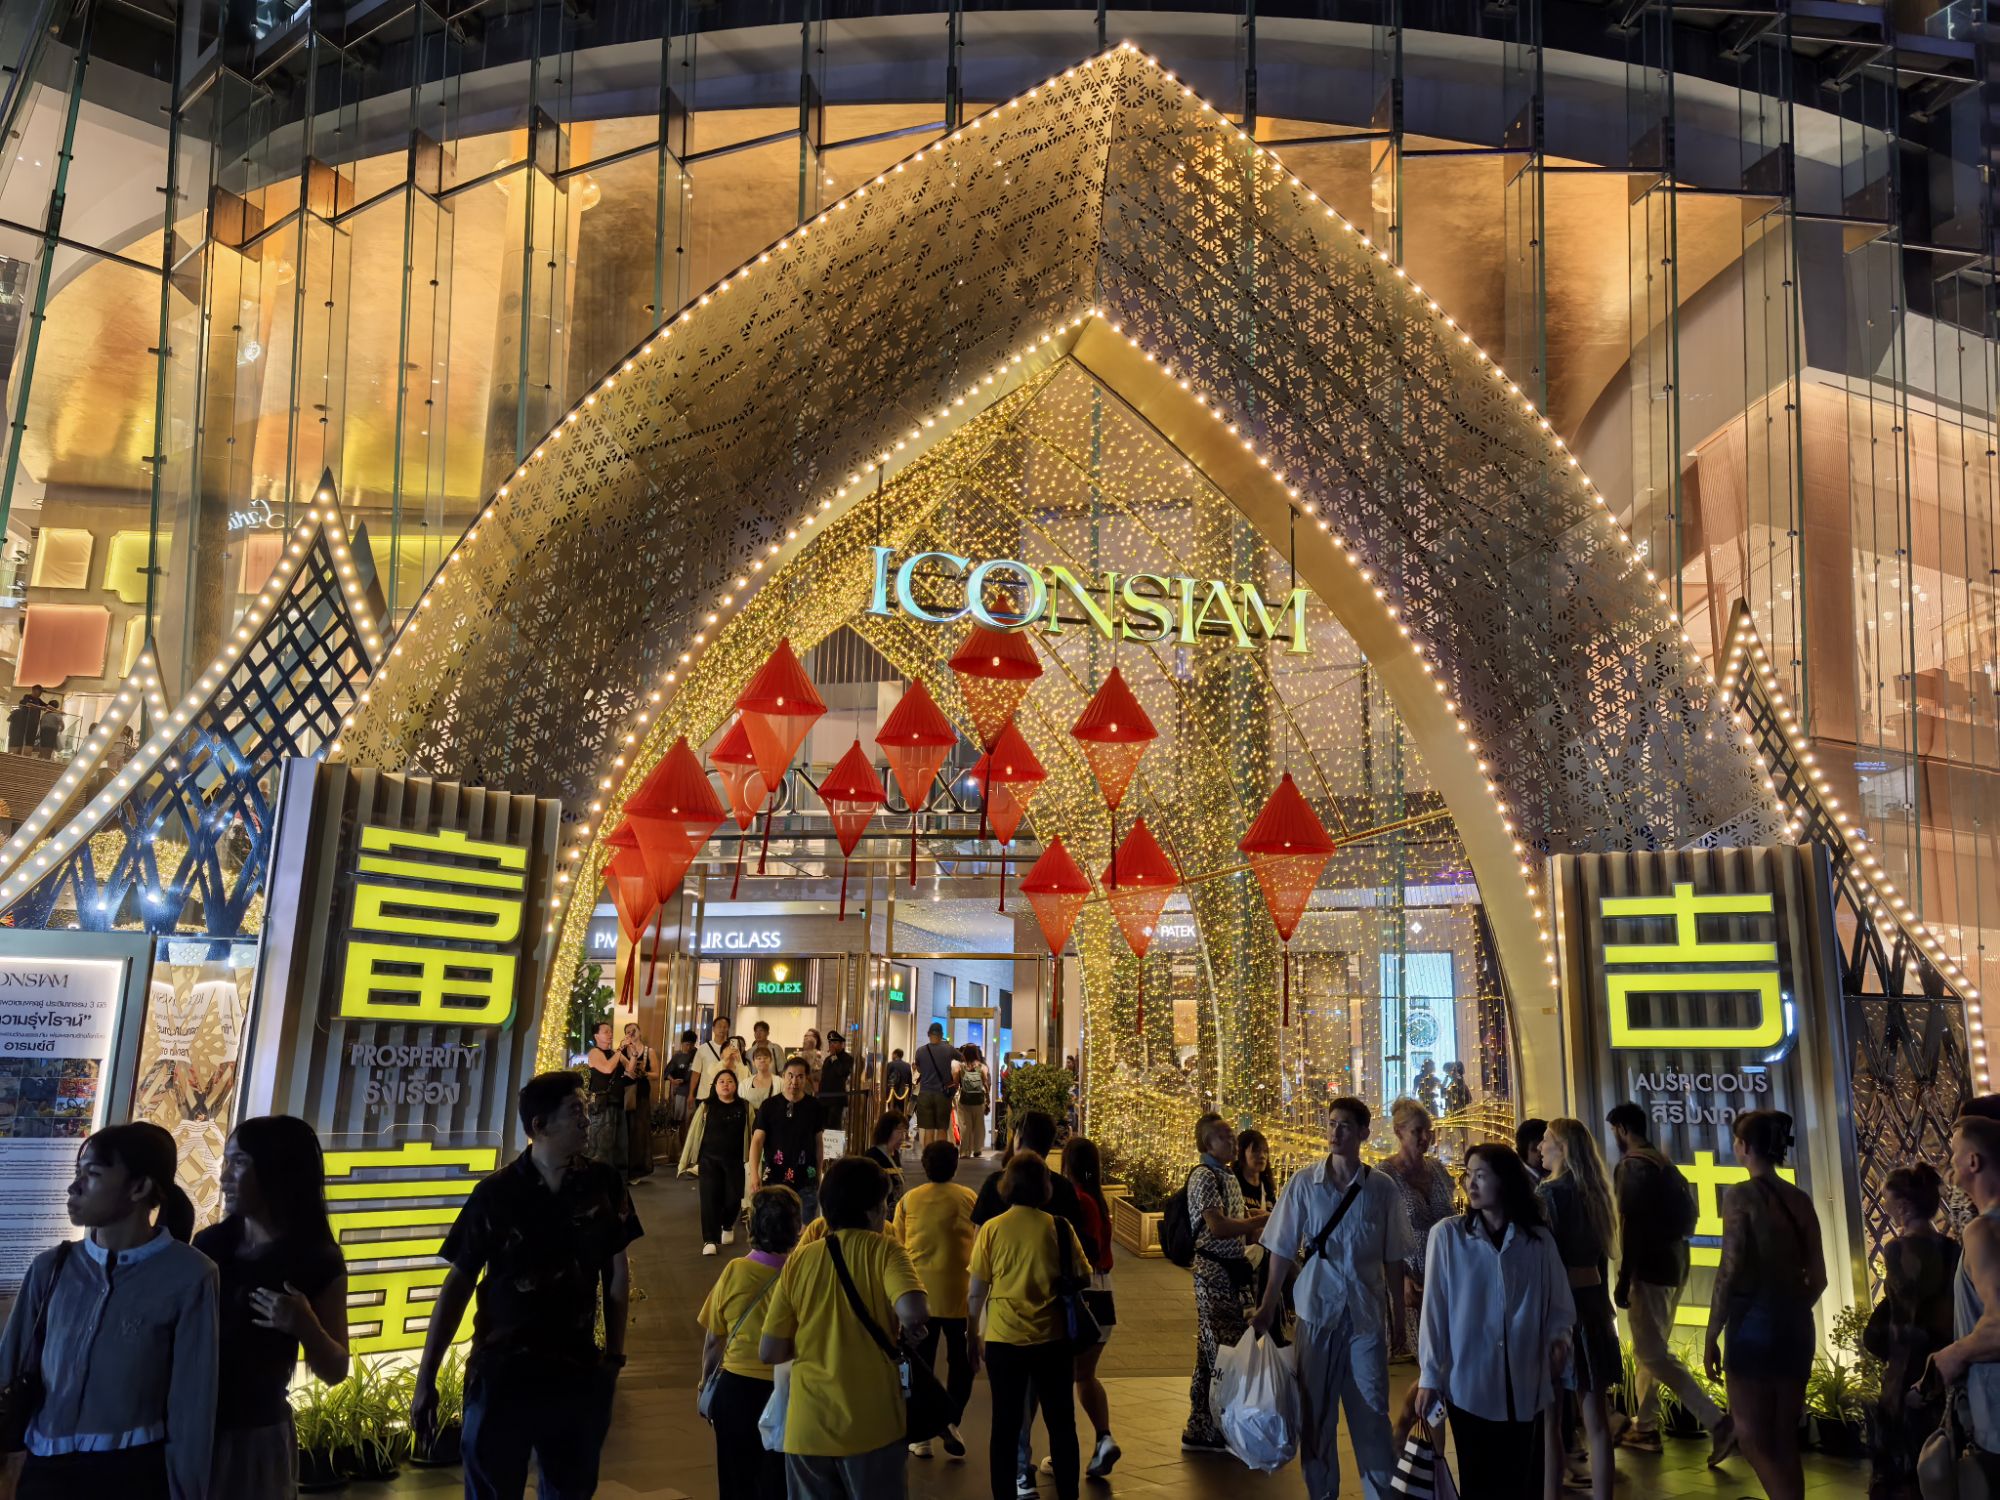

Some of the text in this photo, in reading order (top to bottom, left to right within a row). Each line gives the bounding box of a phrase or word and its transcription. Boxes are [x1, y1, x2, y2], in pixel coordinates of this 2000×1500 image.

[865, 545, 1312, 656] ICONSIAM
[340, 824, 527, 1024] 富
[1160, 925, 1196, 938] PATEK
[594, 932, 618, 949] PM
[725, 932, 781, 949] GLASS
[1601, 883, 1784, 1048] 吉
[757, 981, 802, 994] ROLEX
[0, 1011, 92, 1030] วามรุ่งโรจน์”
[350, 1043, 479, 1069] PROSPERITY
[363, 1069, 461, 1115] รุ่งเรือง
[1635, 1072, 1768, 1093] AUSPICIOUS
